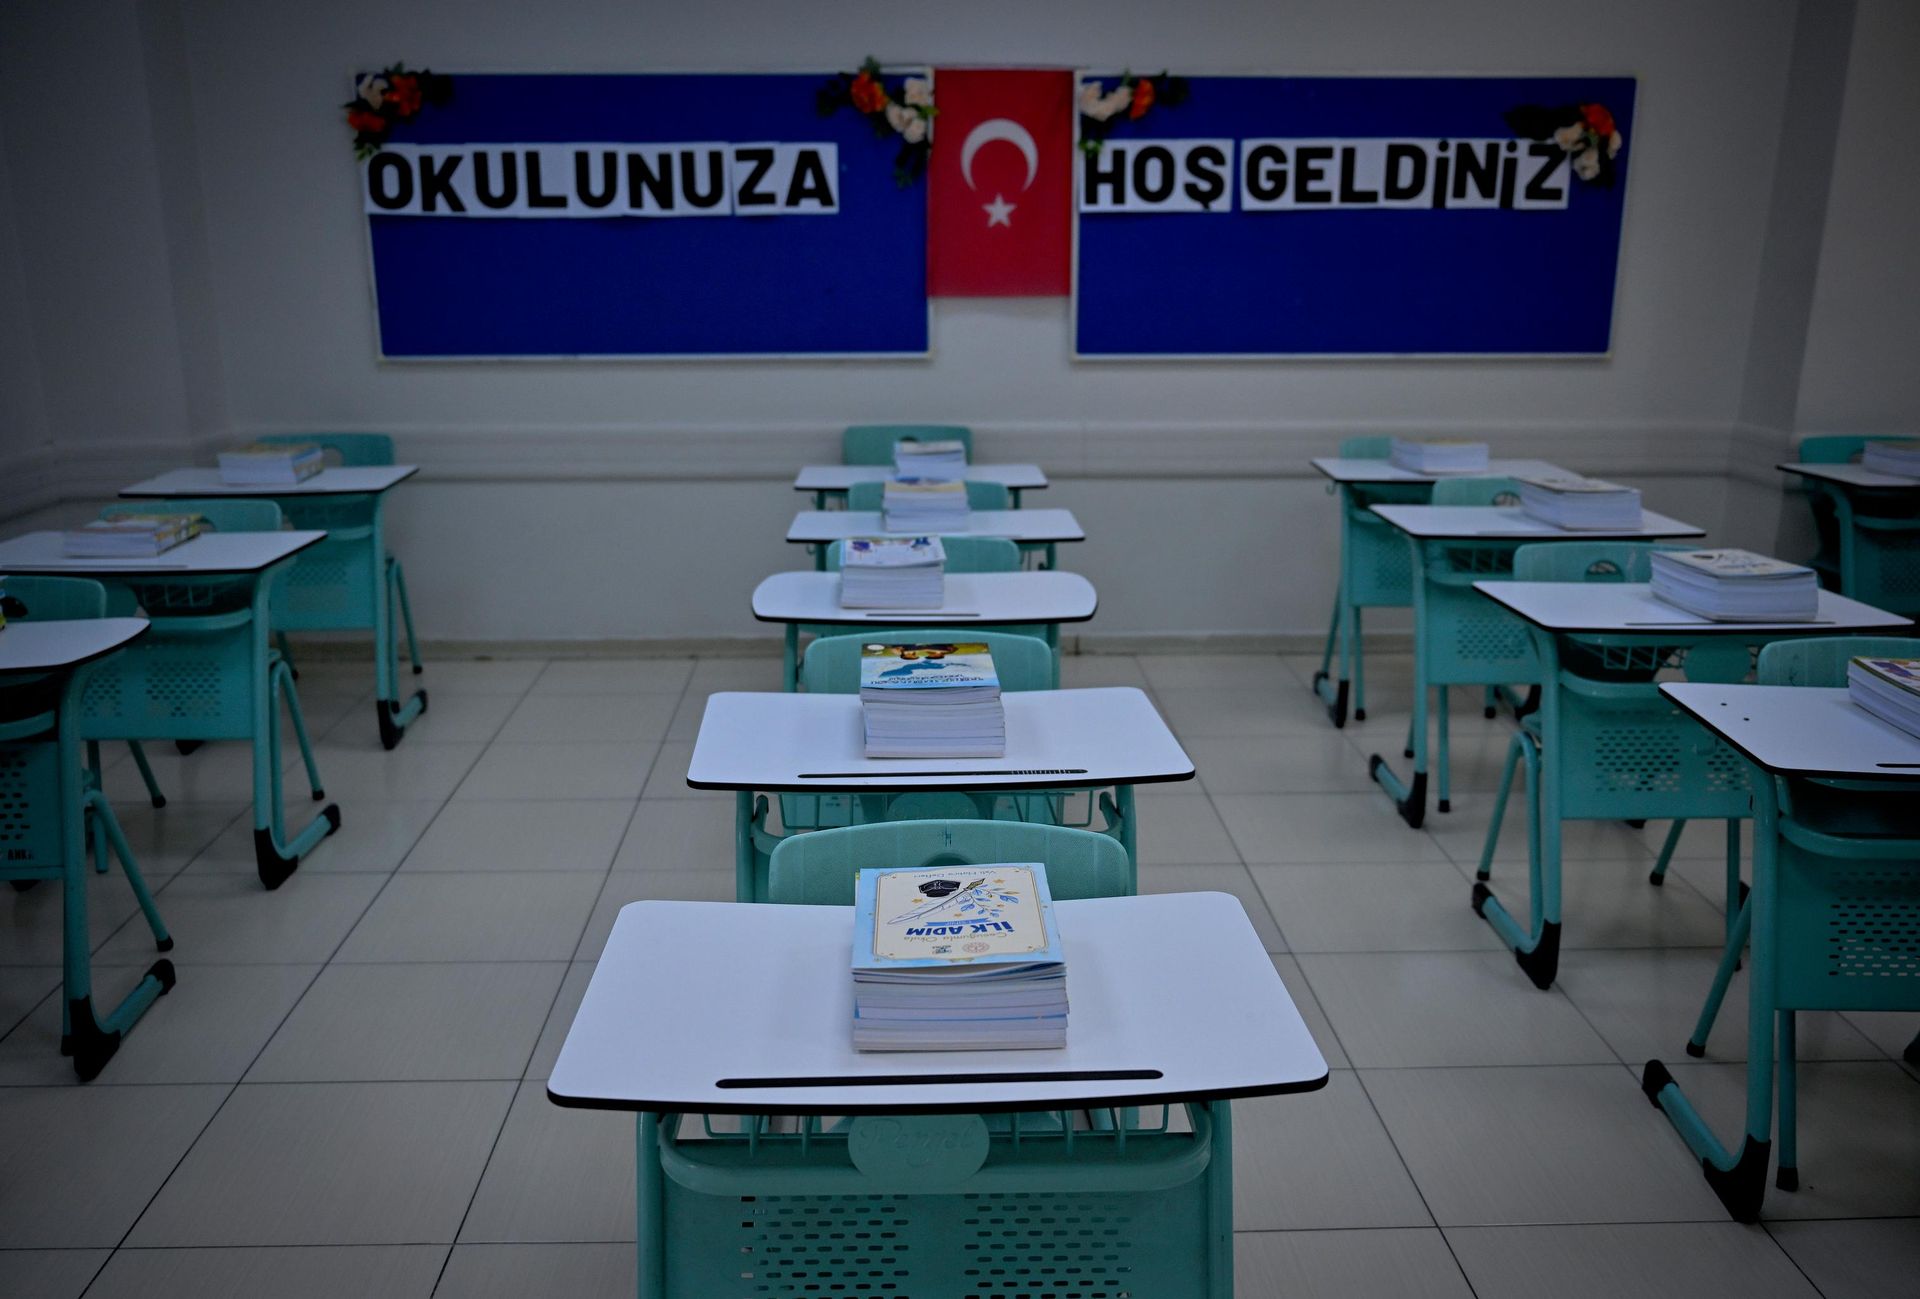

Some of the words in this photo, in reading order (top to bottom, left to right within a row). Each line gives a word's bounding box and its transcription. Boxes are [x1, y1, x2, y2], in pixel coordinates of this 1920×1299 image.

[367, 147, 835, 213] OKULUNUZA
[1083, 143, 1226, 210] HOŞ
[907, 926, 962, 936] ADIM
[967, 920, 1015, 933] İLK
